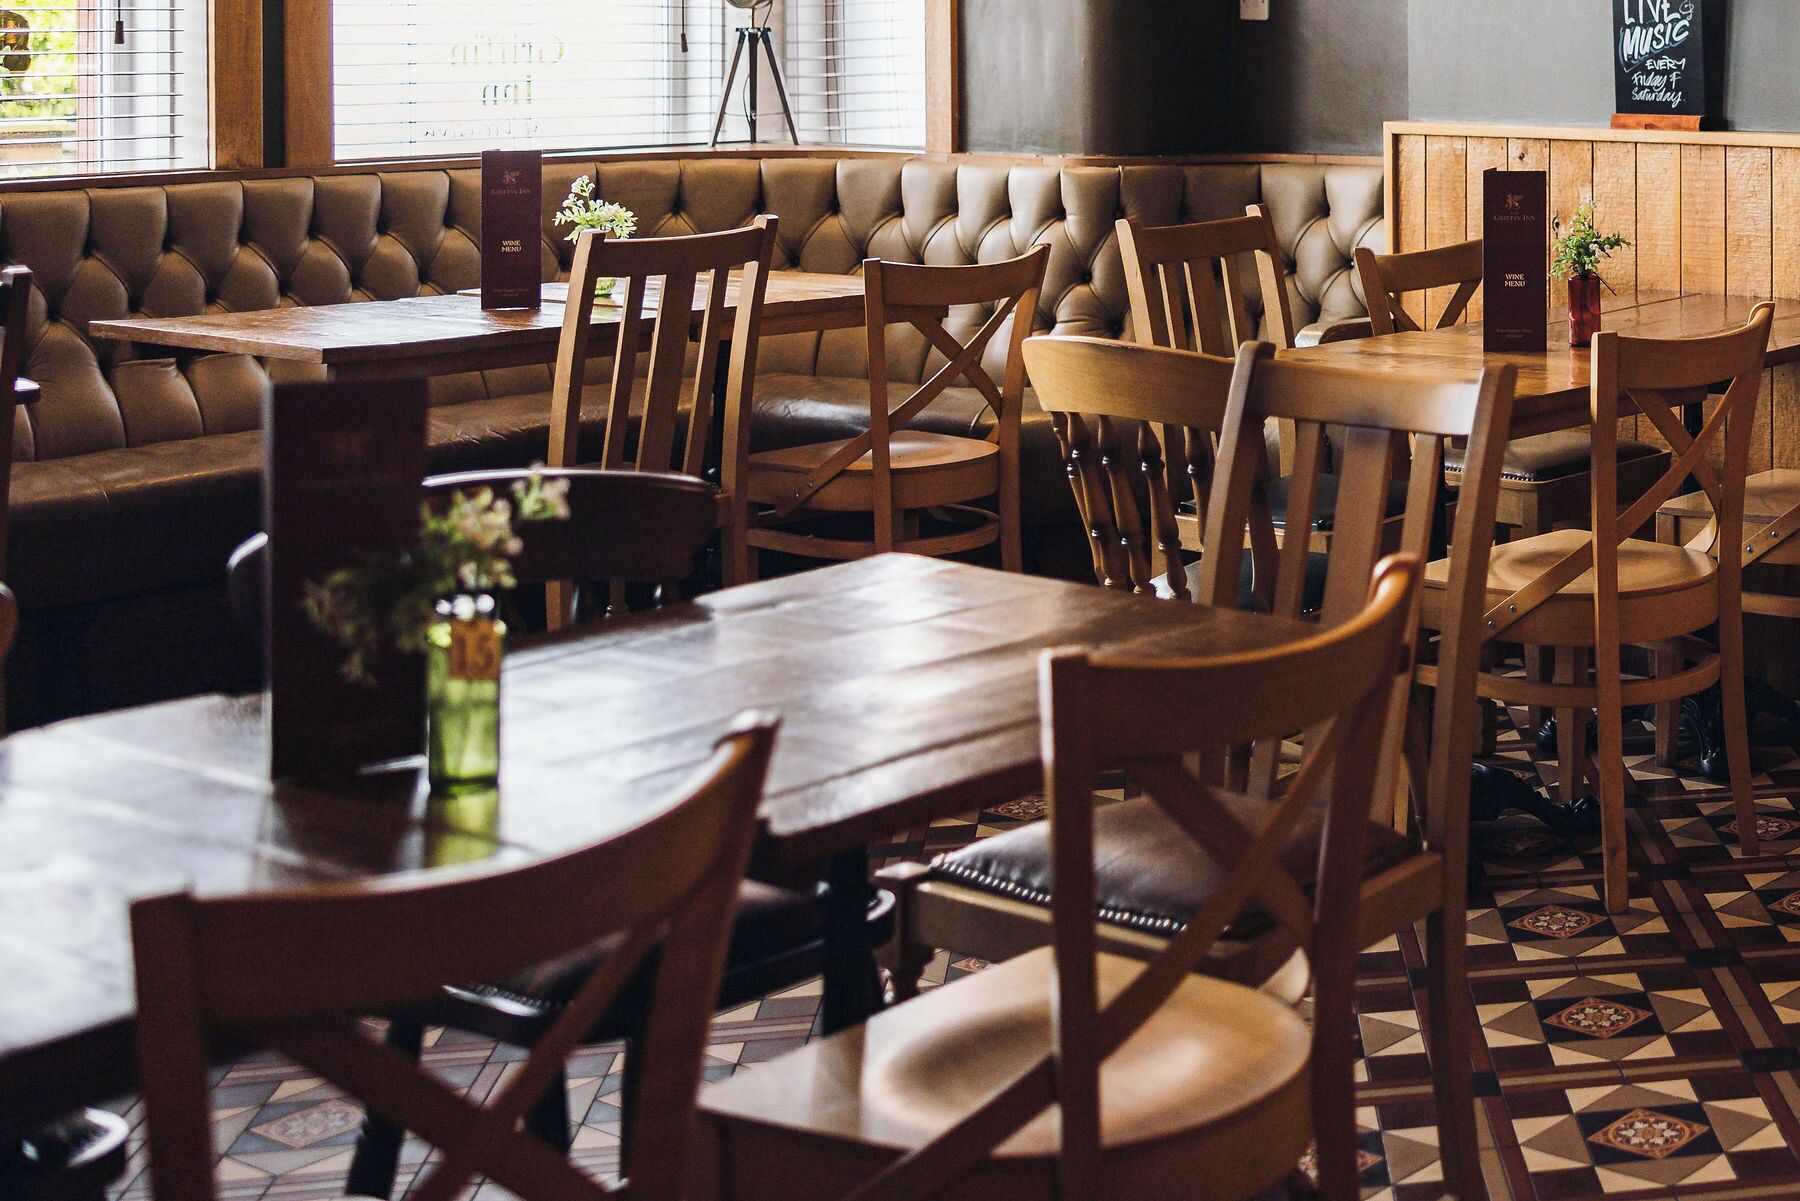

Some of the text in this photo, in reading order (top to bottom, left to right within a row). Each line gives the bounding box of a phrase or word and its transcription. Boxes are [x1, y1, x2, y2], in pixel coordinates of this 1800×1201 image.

[1623, 19, 1690, 62] MUSIC
[1645, 55, 1686, 71] EVERY
[1631, 71, 1667, 92] Friday
